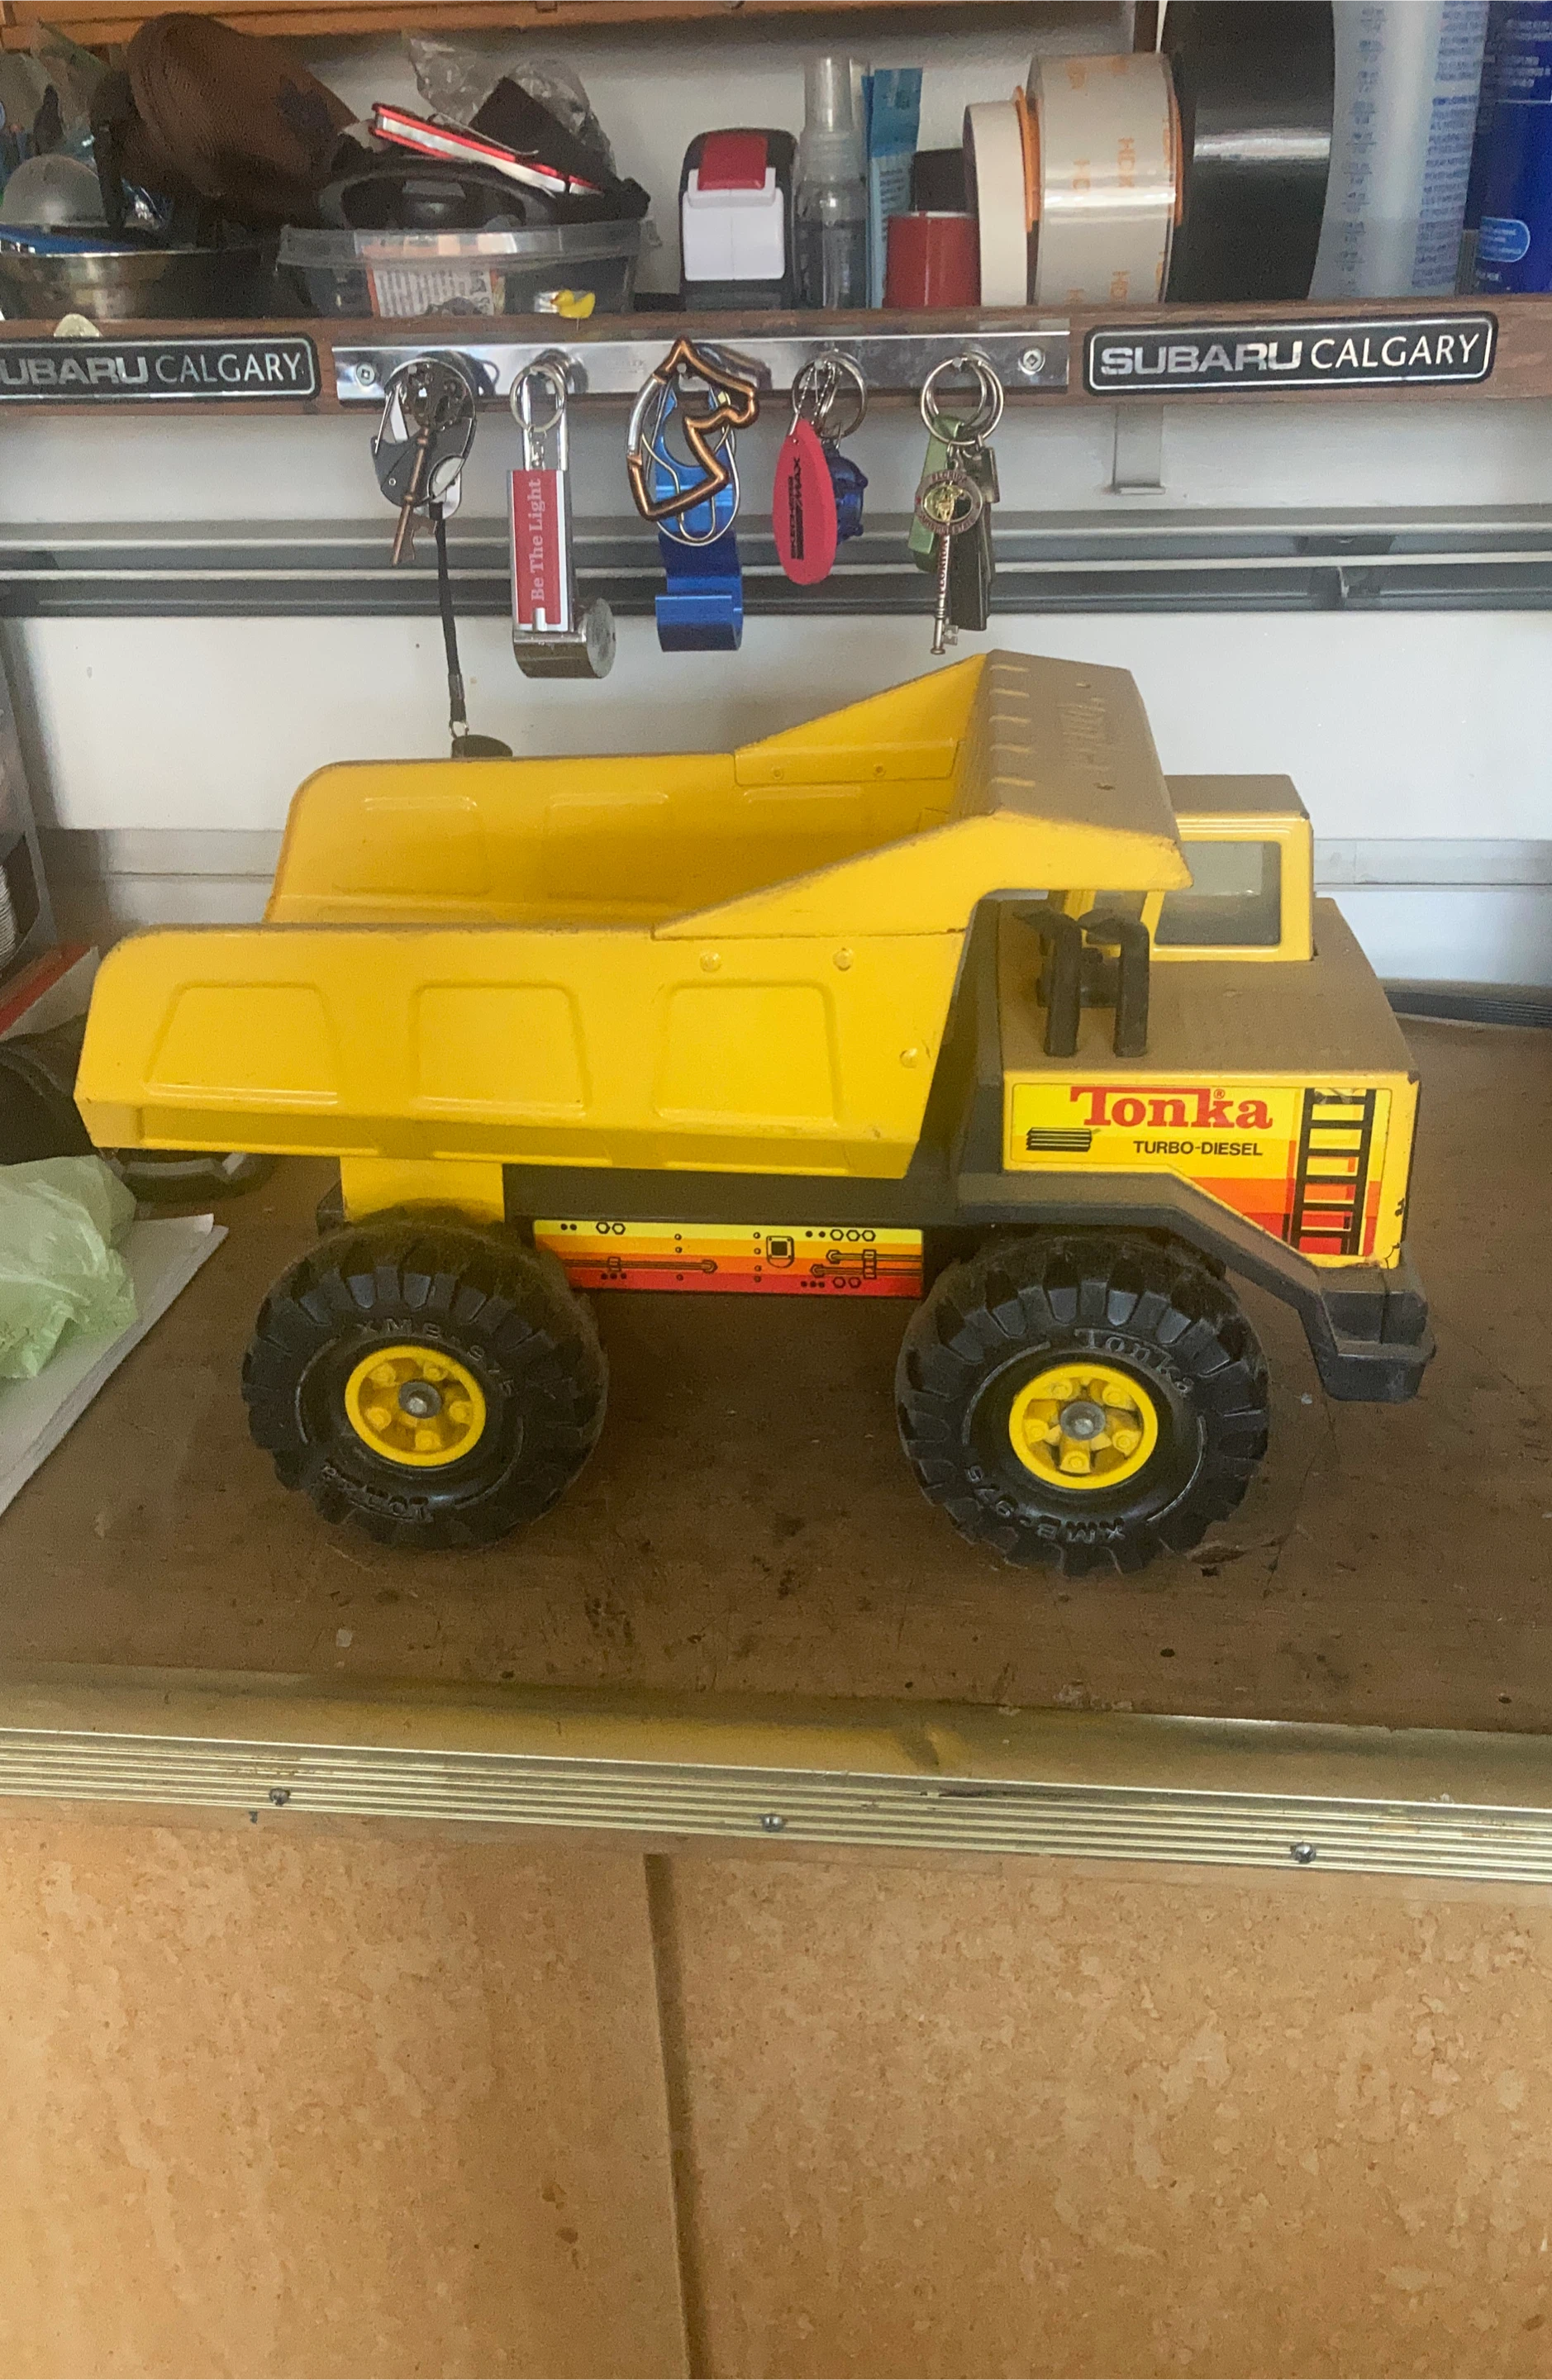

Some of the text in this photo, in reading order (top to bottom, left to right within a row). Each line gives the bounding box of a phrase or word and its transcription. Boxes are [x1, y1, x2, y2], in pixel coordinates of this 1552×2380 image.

[0, 352, 302, 384] UBARU CALGARY
[1101, 333, 1481, 376] SUBARU CALGARY
[527, 478, 545, 602] Be The Light
[1133, 1140, 1264, 1156] TURBO-DIESEL
[1074, 1327, 1195, 1395] Tonka
